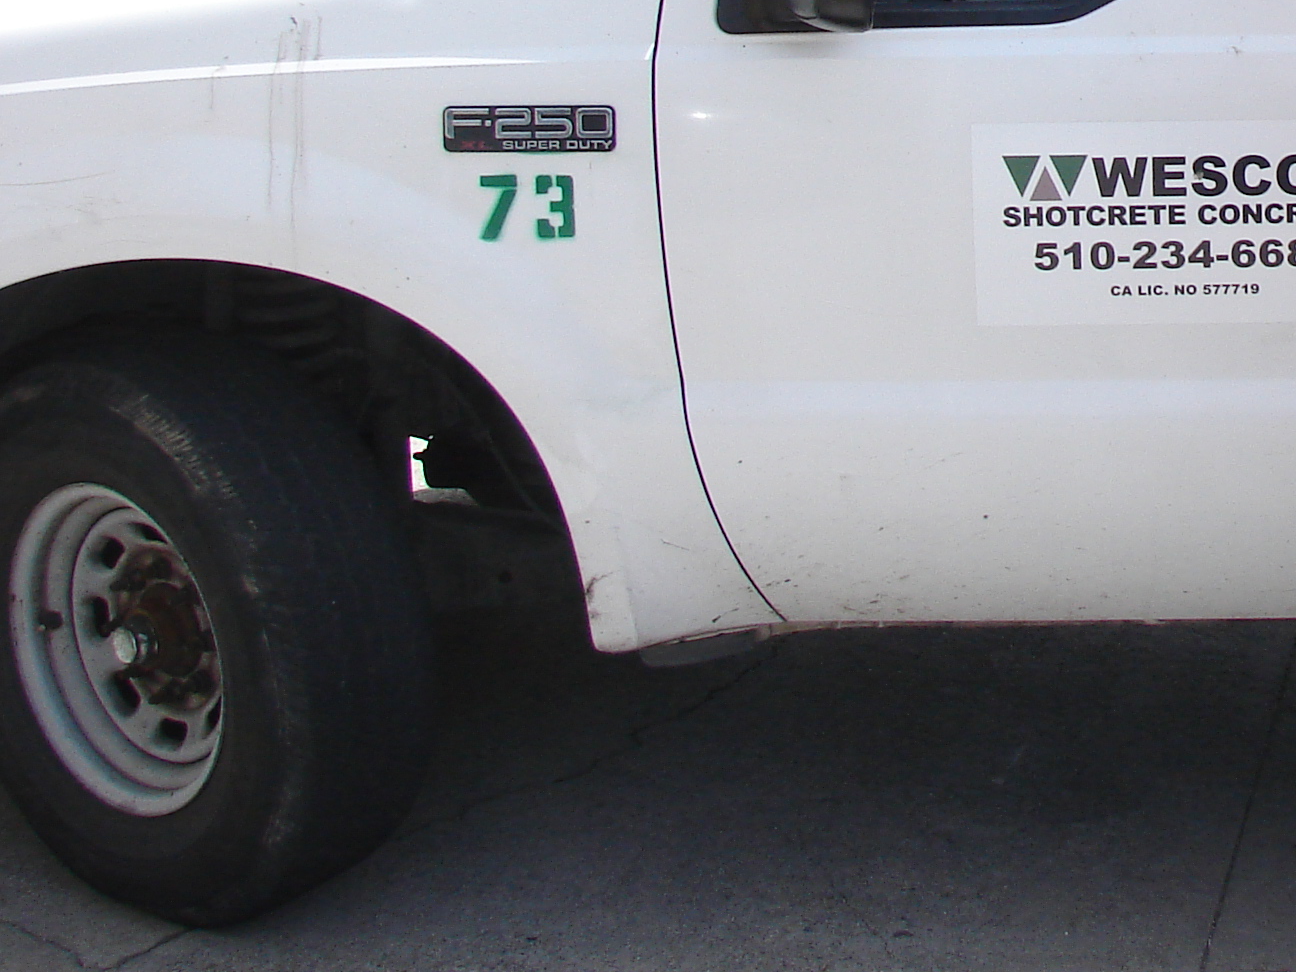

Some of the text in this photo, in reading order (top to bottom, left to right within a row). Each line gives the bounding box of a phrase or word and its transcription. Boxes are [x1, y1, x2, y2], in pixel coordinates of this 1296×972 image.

[444, 107, 614, 139] F-250
[502, 140, 560, 150] SUPER
[566, 140, 613, 150] DUTY
[480, 174, 576, 242] 73
[1003, 205, 1186, 227] SHOTCRETE
[1110, 284, 1260, 296] CA LIC. NO 577719
